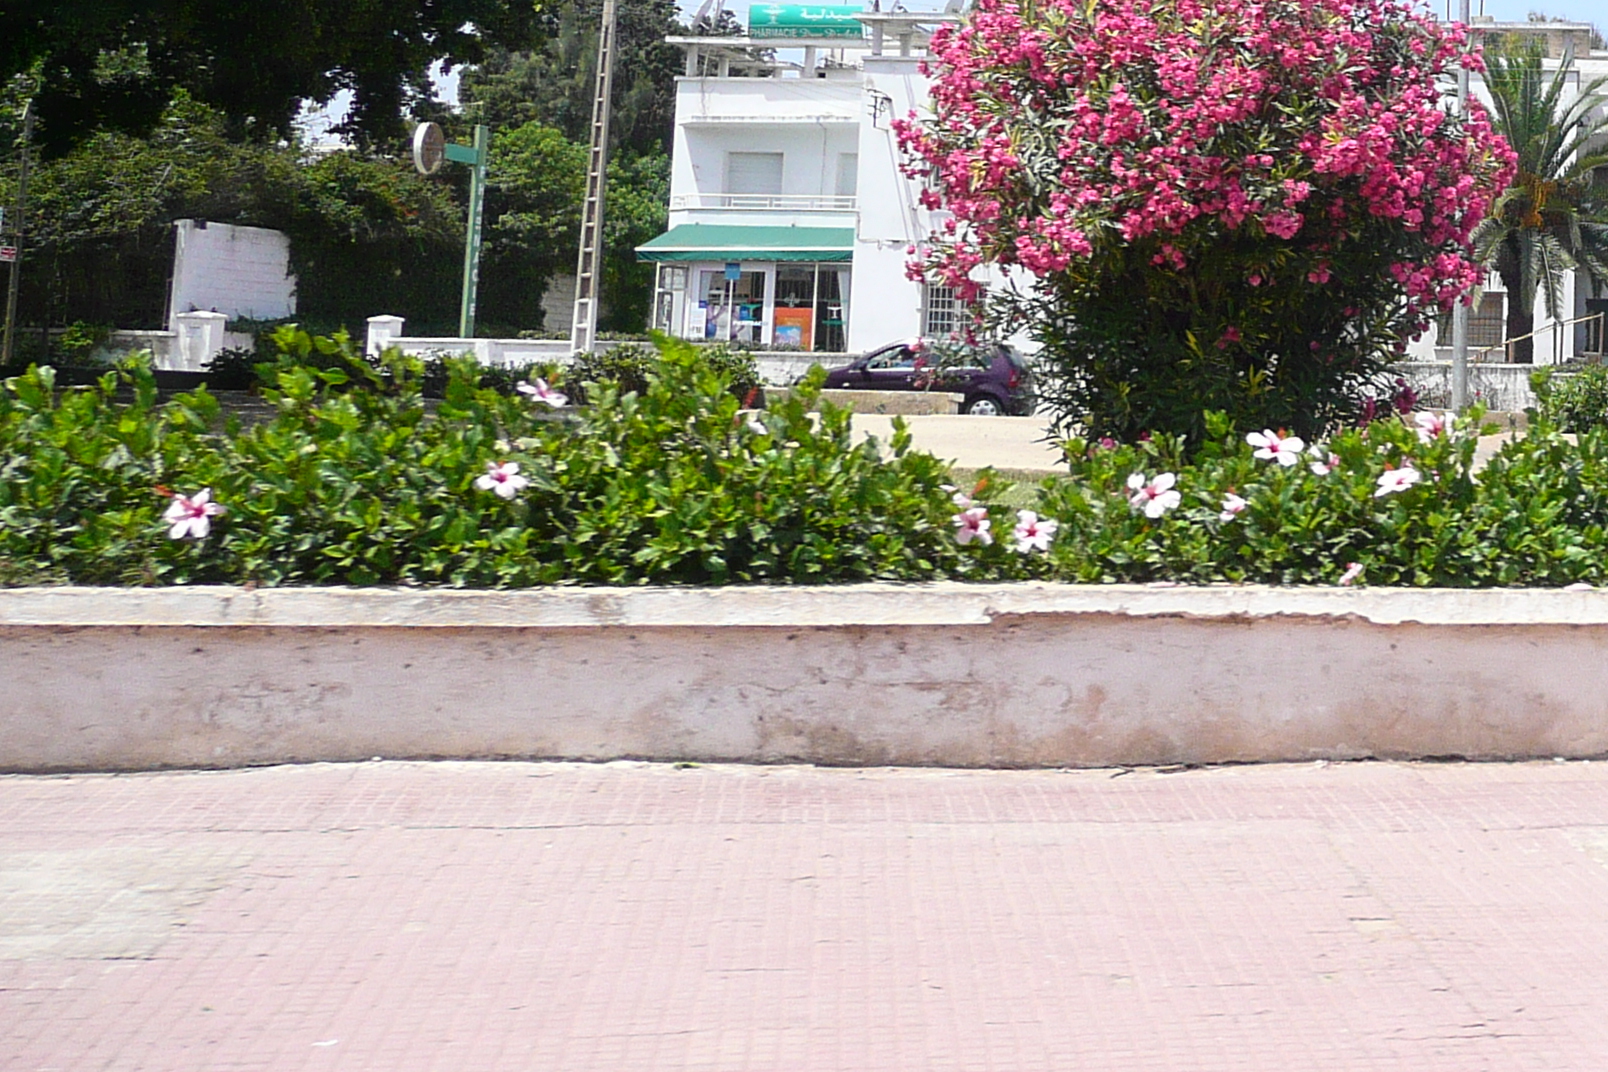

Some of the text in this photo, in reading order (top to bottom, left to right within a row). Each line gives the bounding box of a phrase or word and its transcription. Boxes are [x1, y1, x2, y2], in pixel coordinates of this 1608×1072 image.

[800, 8, 853, 22] يدلية
[749, 28, 797, 38] PHARMACIE
[469, 166, 486, 316] PHARMACIE
